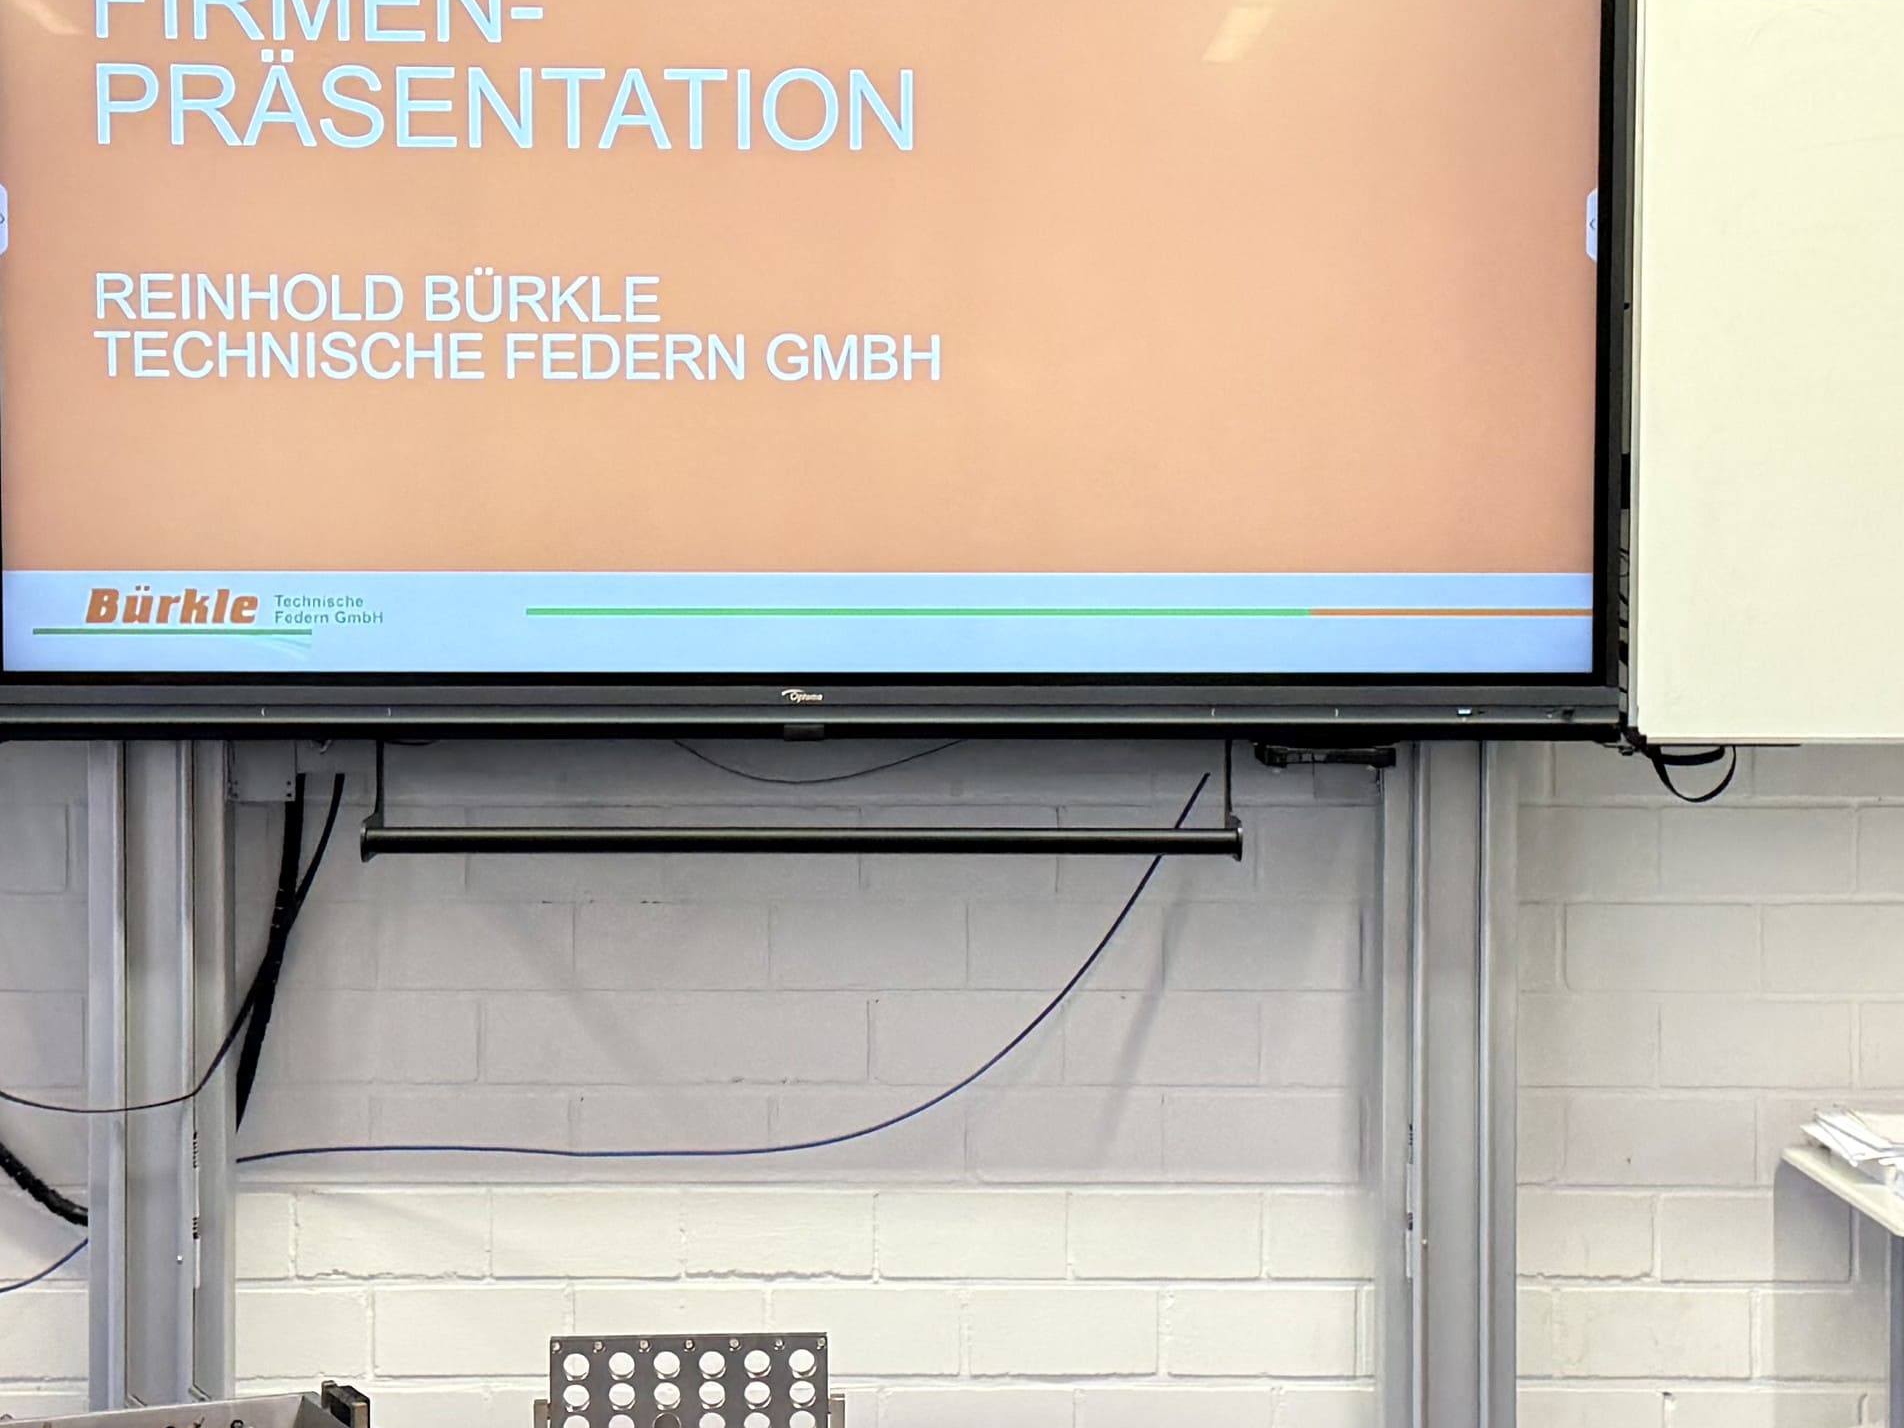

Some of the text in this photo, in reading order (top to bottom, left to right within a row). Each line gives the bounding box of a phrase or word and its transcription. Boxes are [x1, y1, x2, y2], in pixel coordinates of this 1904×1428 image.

[94, 49, 913, 151] PRÄSENTATION
[95, 267, 660, 323] REINHOLD BÜRKLE
[94, 329, 940, 381] TECHNISCHE FEDERN GMBH
[86, 586, 258, 623] Bürkle
[275, 595, 363, 607] Technische
[275, 611, 383, 623] Federn GmbH
